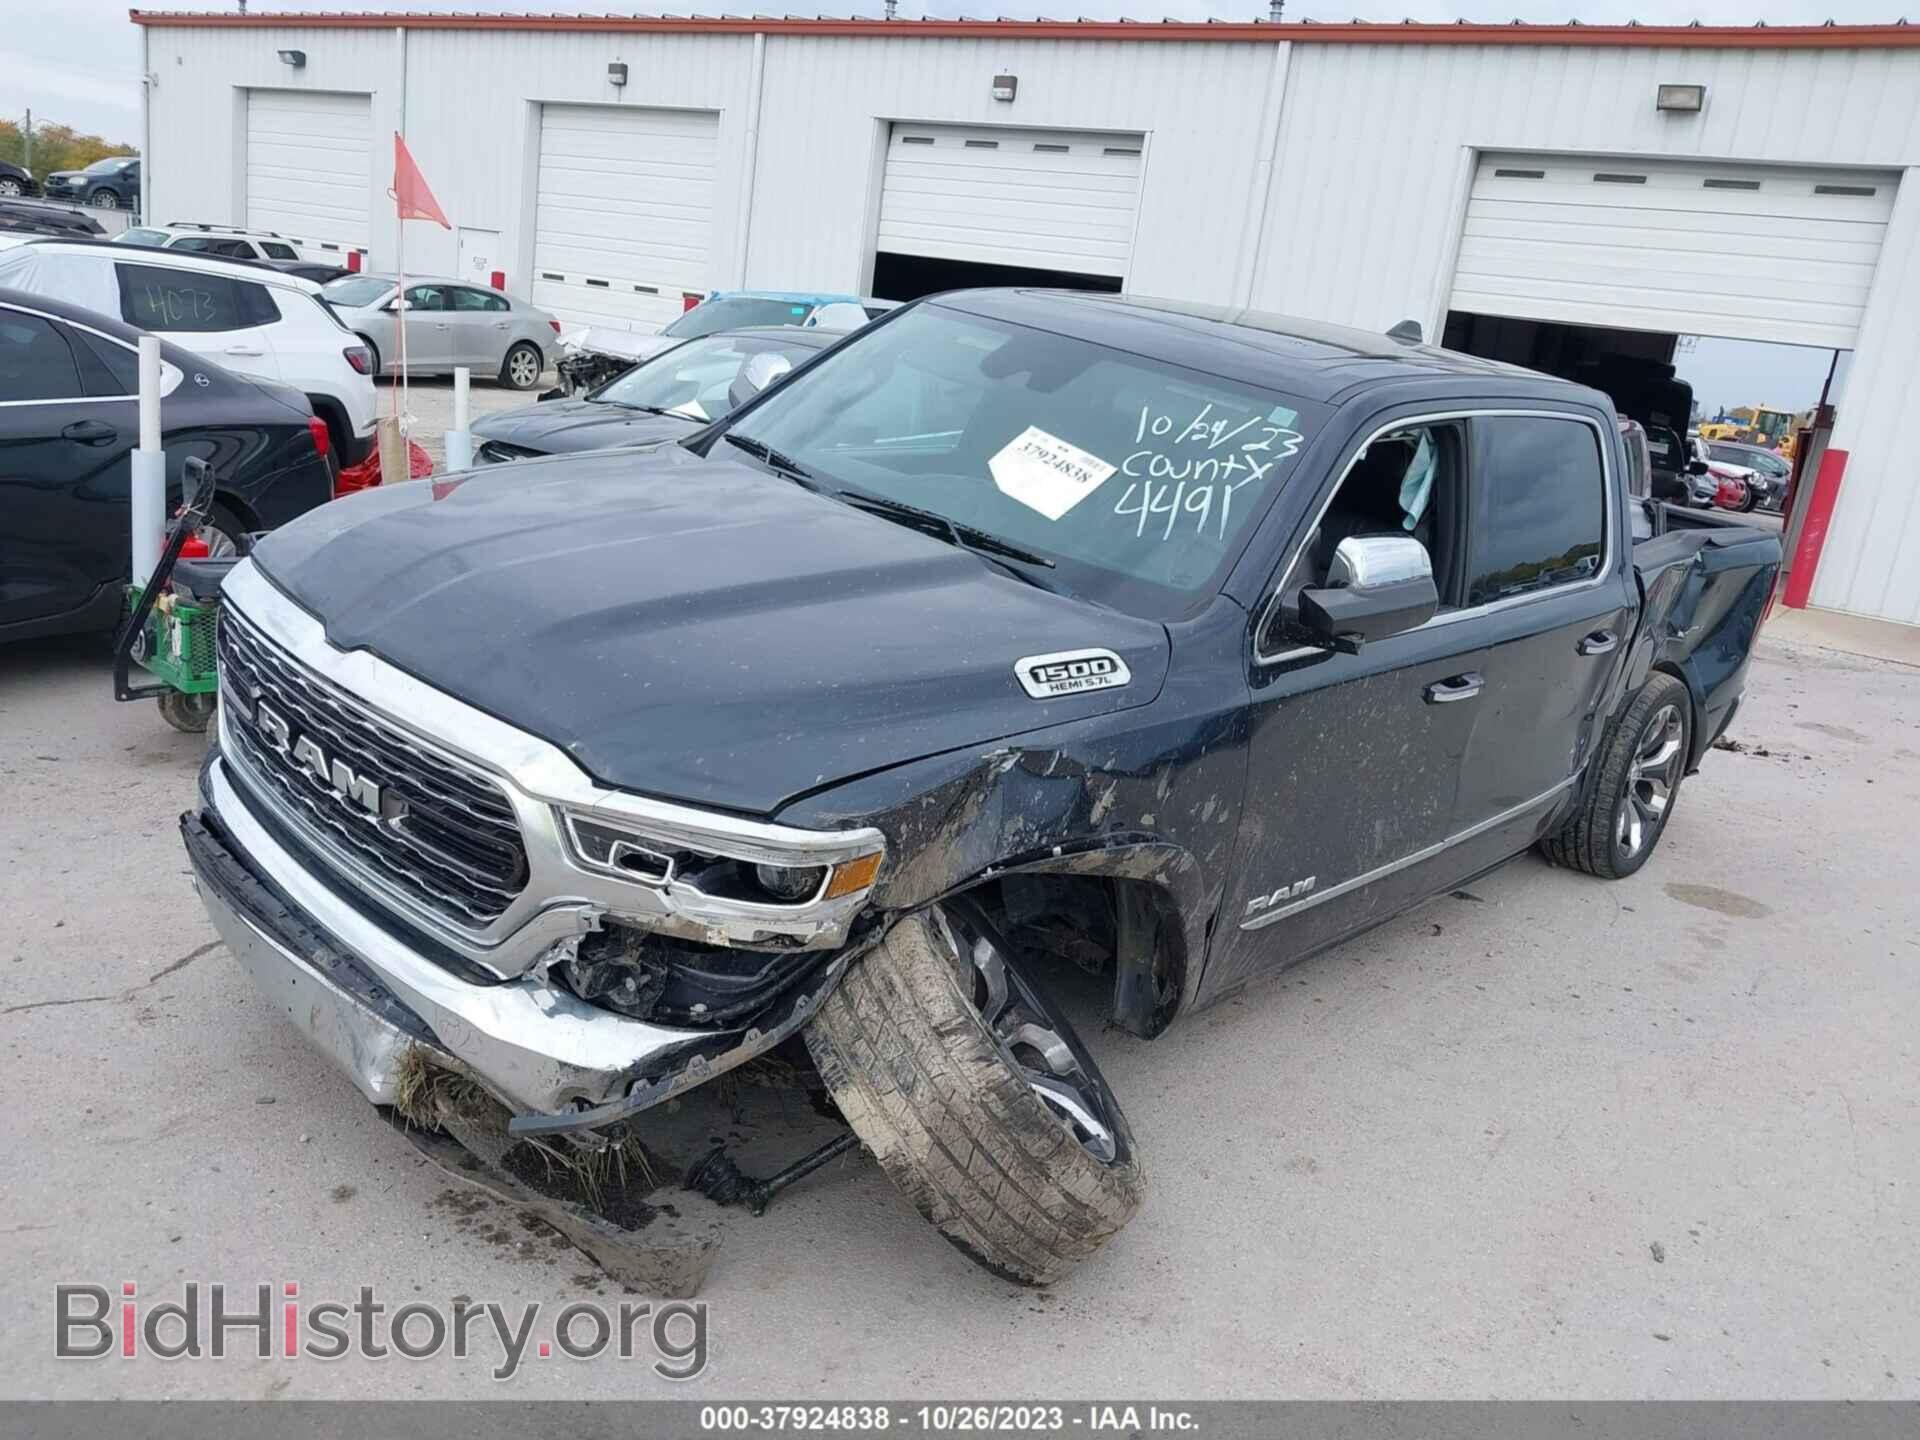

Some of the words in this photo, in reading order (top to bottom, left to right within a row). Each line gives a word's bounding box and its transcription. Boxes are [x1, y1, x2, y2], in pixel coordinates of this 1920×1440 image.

[1015, 441, 1093, 484] 37924838
[1113, 480, 1232, 541] 4491
[1031, 659, 1112, 683] 1500
[1049, 680, 1082, 692] HEMI
[1085, 676, 1112, 687] 5.7L
[258, 700, 380, 816] RAM
[1245, 875, 1316, 915] RAM
